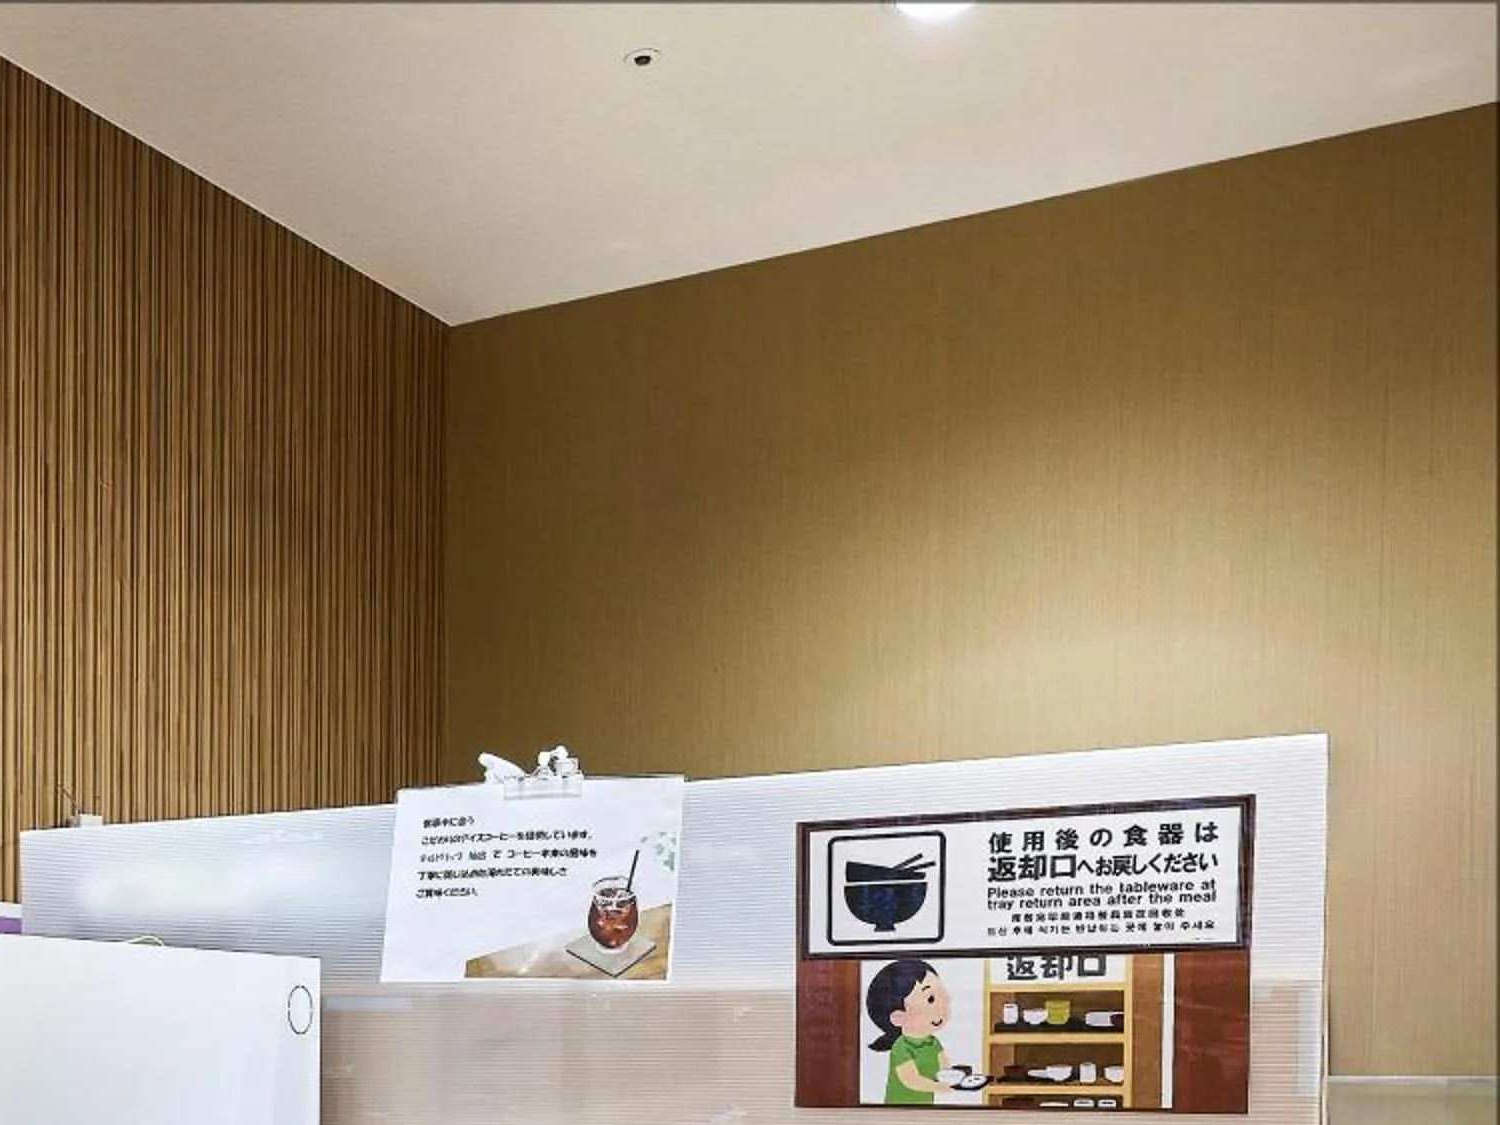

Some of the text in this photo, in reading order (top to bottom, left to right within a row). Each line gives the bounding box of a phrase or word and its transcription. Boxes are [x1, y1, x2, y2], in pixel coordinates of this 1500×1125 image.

[988, 822, 1219, 853] 使用後の食器は
[987, 852, 1219, 882] 返却口へお戻しください
[987, 878, 1216, 898] Please return the tableware at
[987, 890, 1217, 911] tray return area after the meal
[1007, 954, 1106, 980] 返却口
